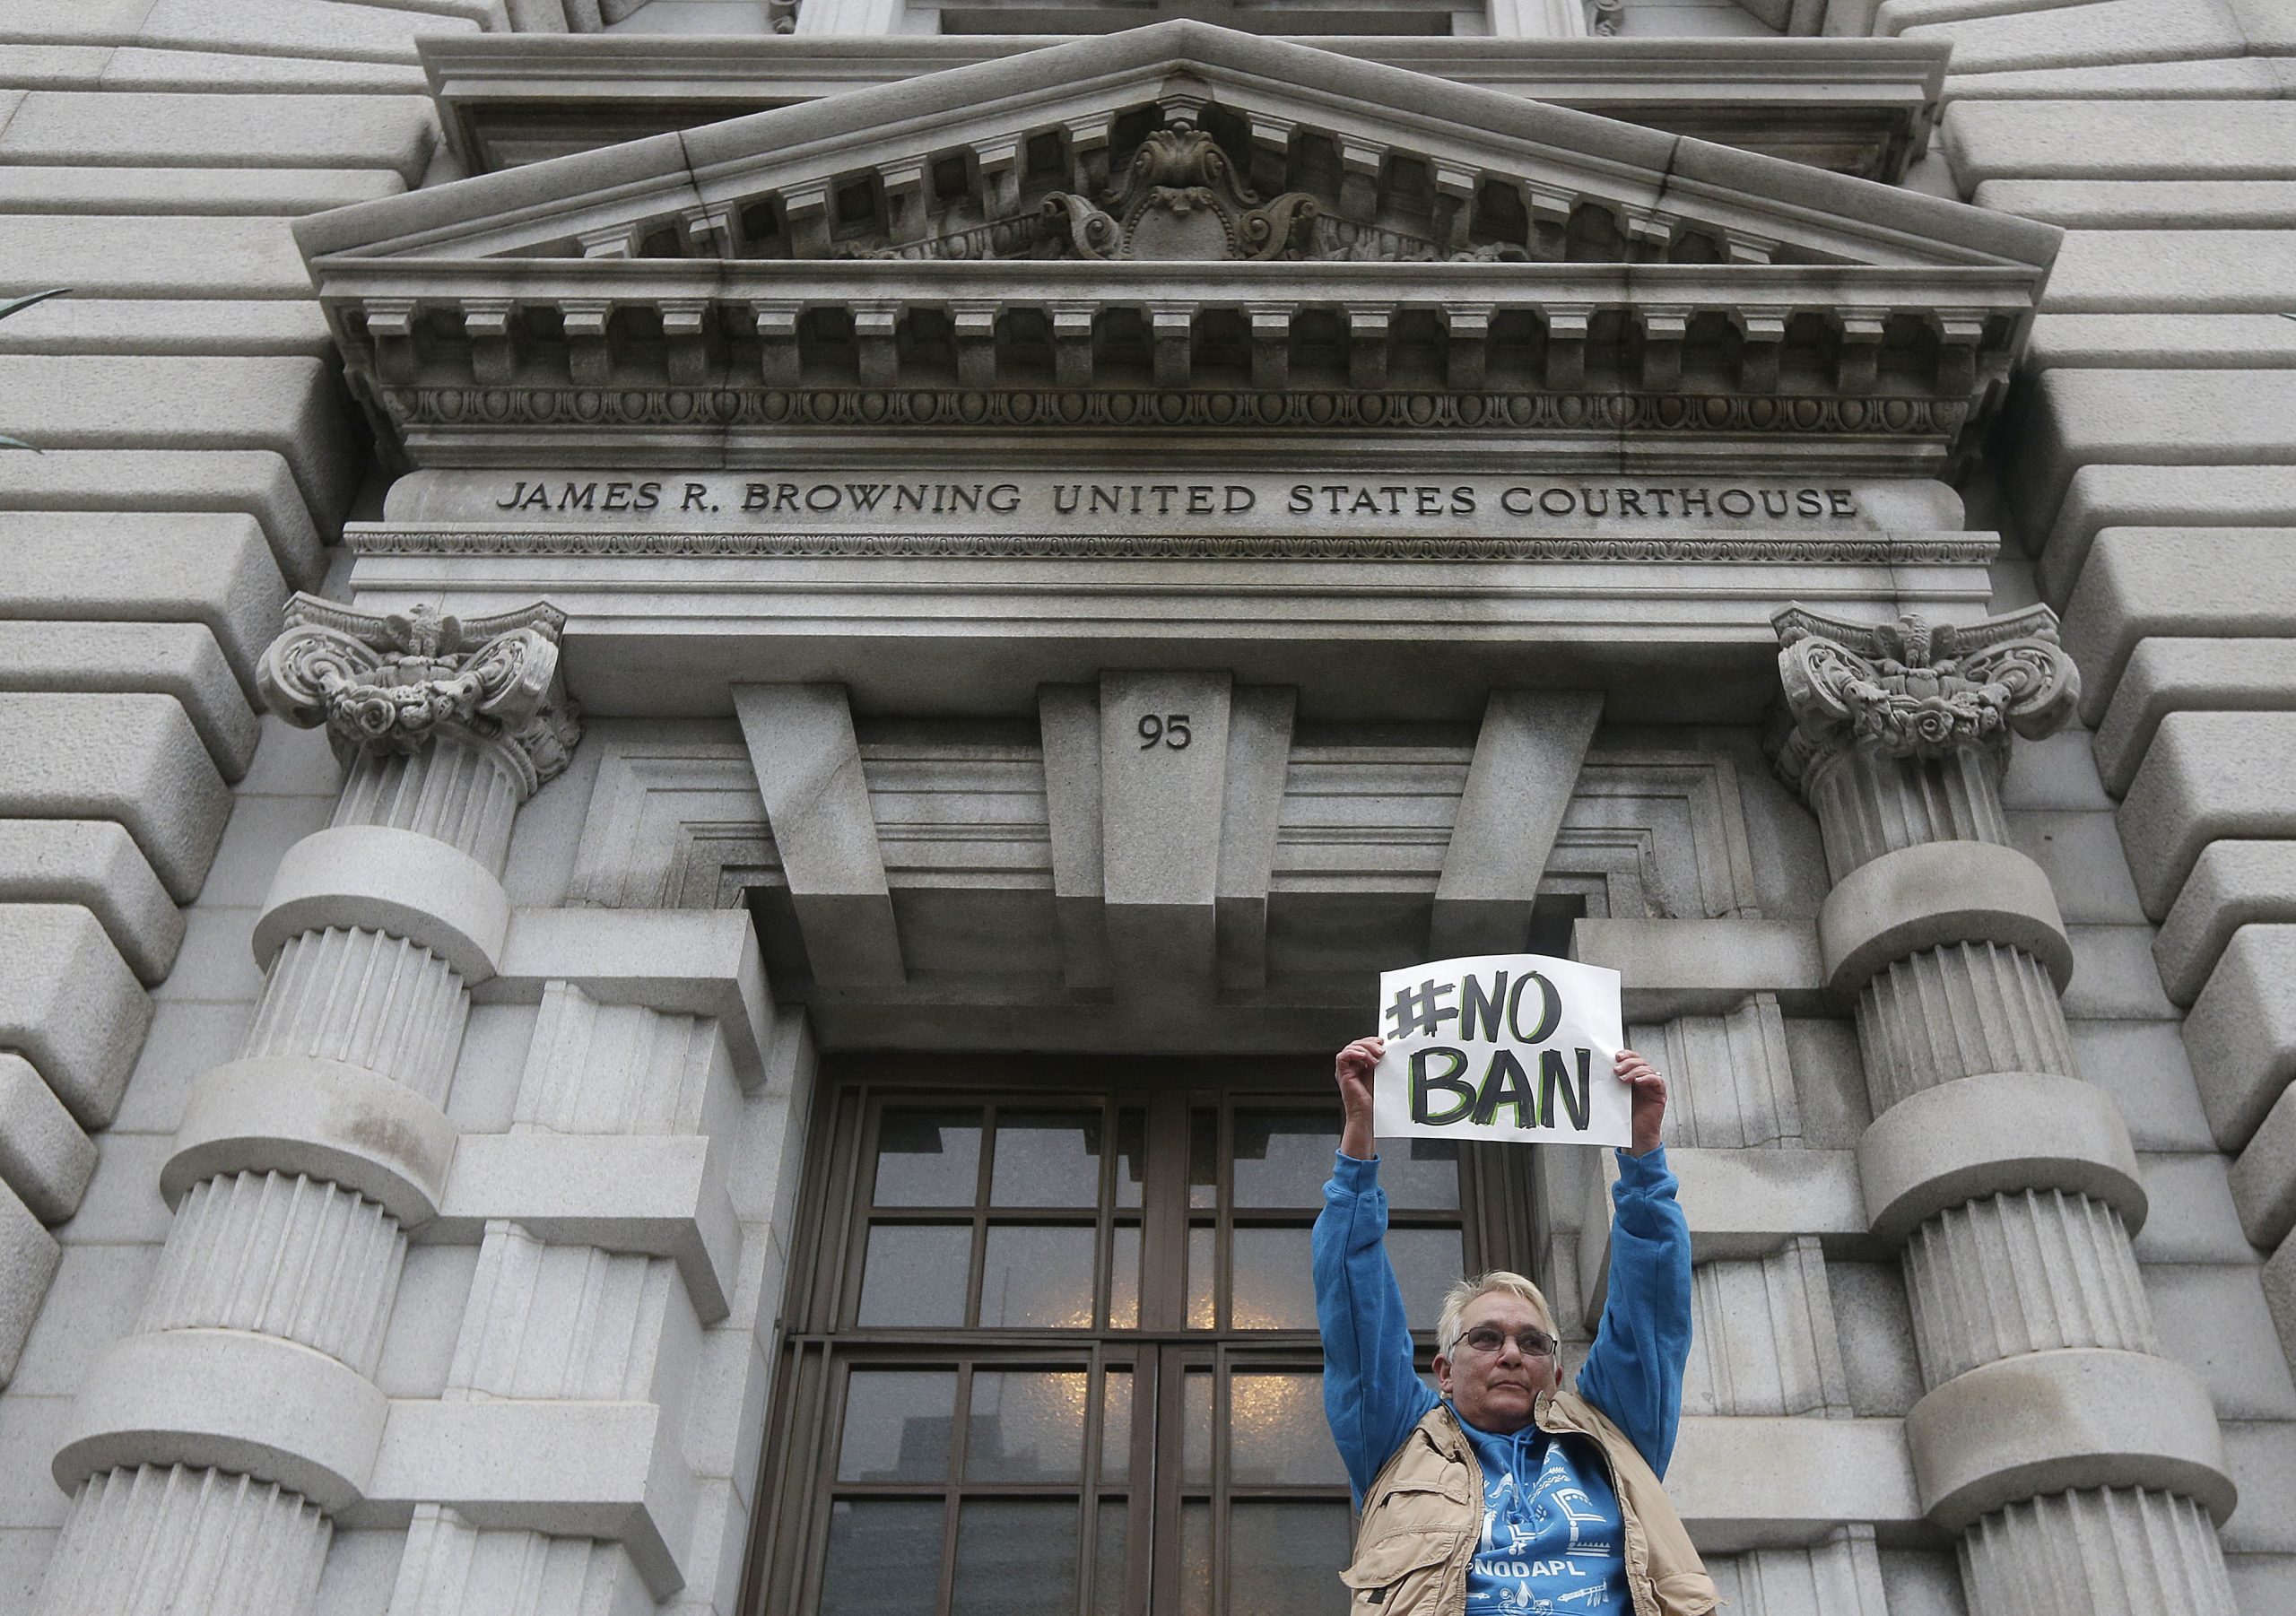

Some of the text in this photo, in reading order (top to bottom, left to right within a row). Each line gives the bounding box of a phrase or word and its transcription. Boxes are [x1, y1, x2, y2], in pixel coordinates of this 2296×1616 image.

[497, 482, 1857, 517] JAMES R. BROWNING UNITED STATES COURTHOUSE
[1138, 714, 1191, 750] 95
[1386, 970, 1562, 1044] #NO
[1408, 1047, 1591, 1131] BAN
[1474, 1559, 1587, 1577] NODAPL
